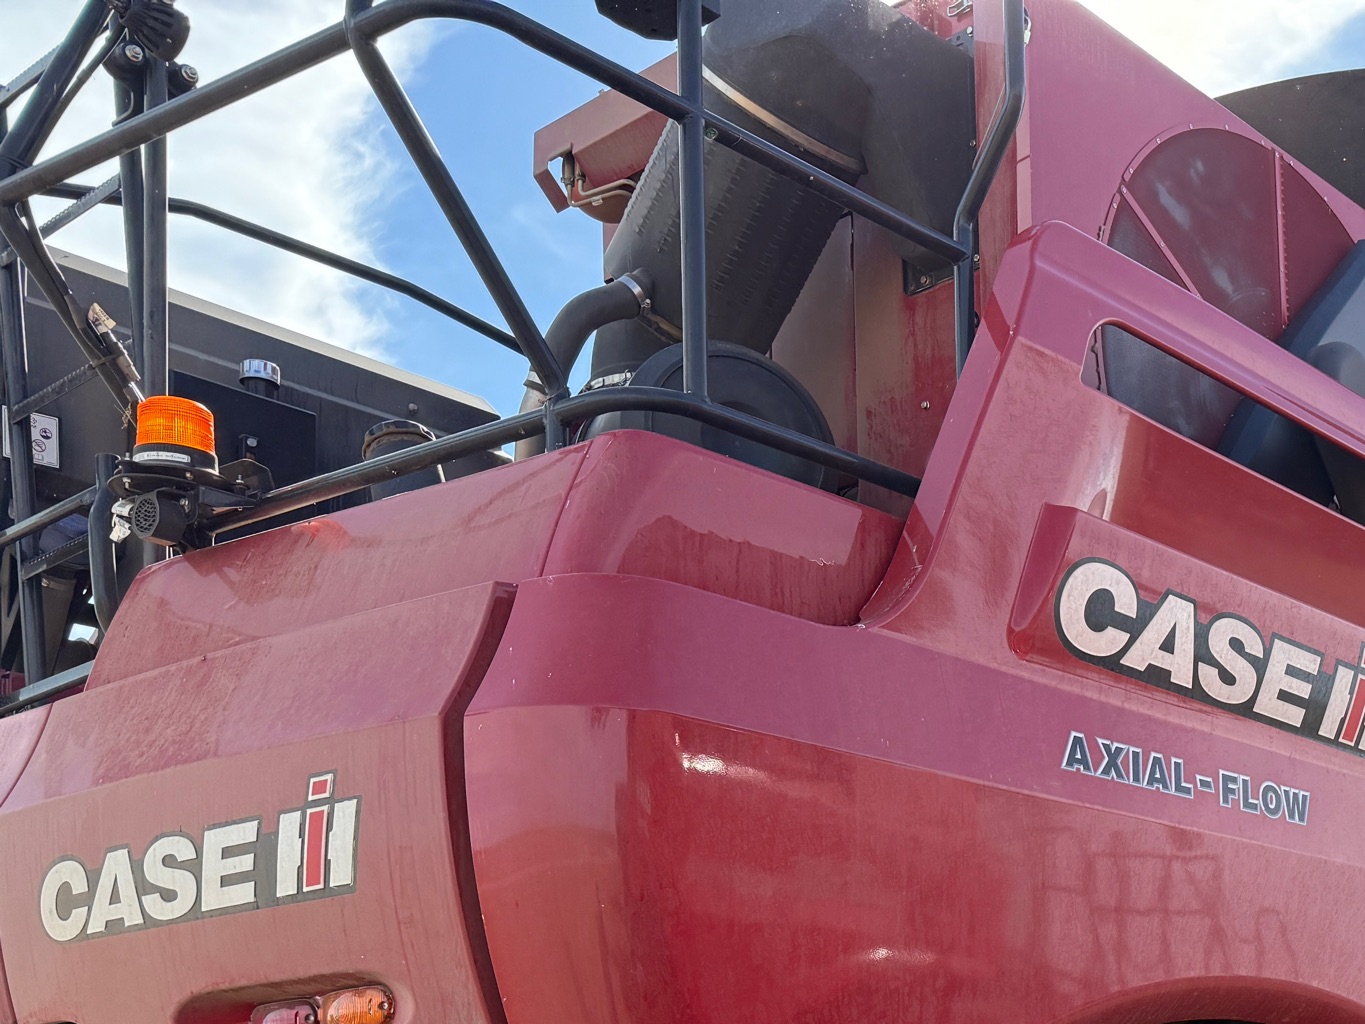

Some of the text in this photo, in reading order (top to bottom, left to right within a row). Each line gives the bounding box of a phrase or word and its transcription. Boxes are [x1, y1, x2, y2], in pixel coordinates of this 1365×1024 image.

[1059, 561, 1322, 728] CASE
[1061, 731, 1311, 826] AXIAL-FLOW
[39, 819, 261, 942] CASE
